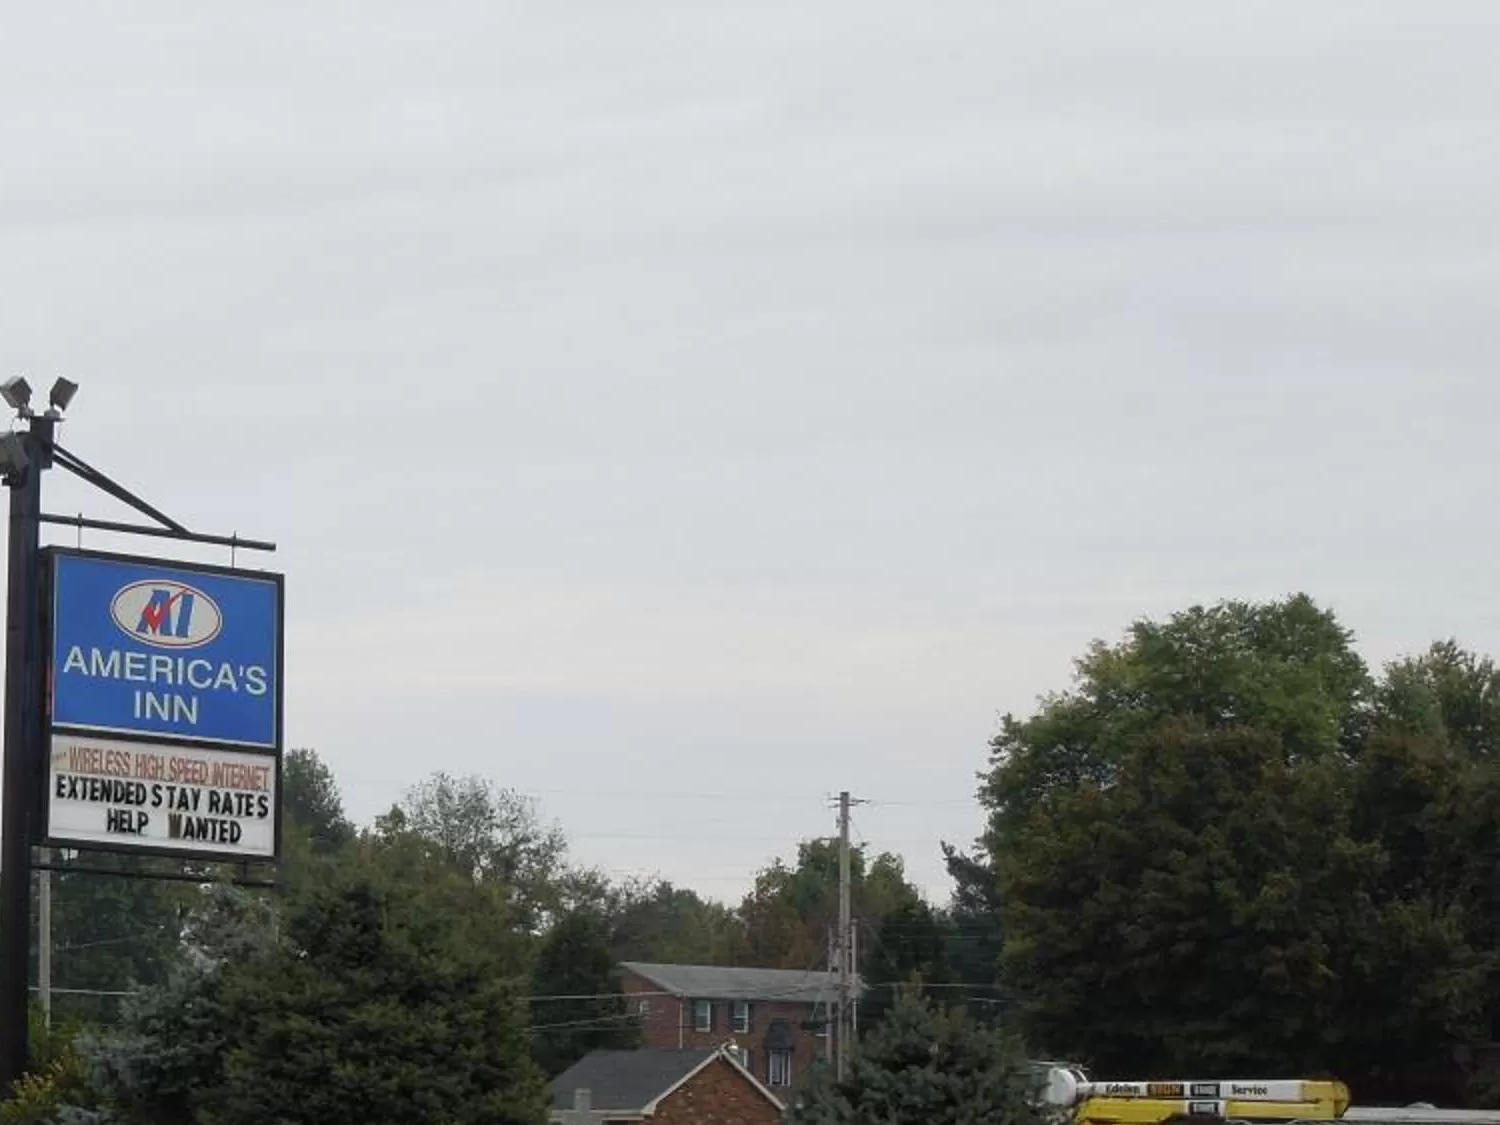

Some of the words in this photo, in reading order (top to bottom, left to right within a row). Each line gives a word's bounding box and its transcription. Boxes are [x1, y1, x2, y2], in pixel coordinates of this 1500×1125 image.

[63, 645, 267, 695] AMERICA'S
[133, 690, 199, 725] INN
[69, 746, 132, 777] WIRELESS
[135, 753, 165, 779] HIGH
[169, 756, 209, 784] SPEED
[211, 762, 270, 792] INTERNET
[56, 774, 147, 806] EXTENDED
[151, 784, 201, 812] STAY
[208, 789, 269, 819] RATES
[106, 808, 149, 833] HELP
[168, 813, 242, 844] WANTED
[1231, 1083, 1268, 1096] Service
